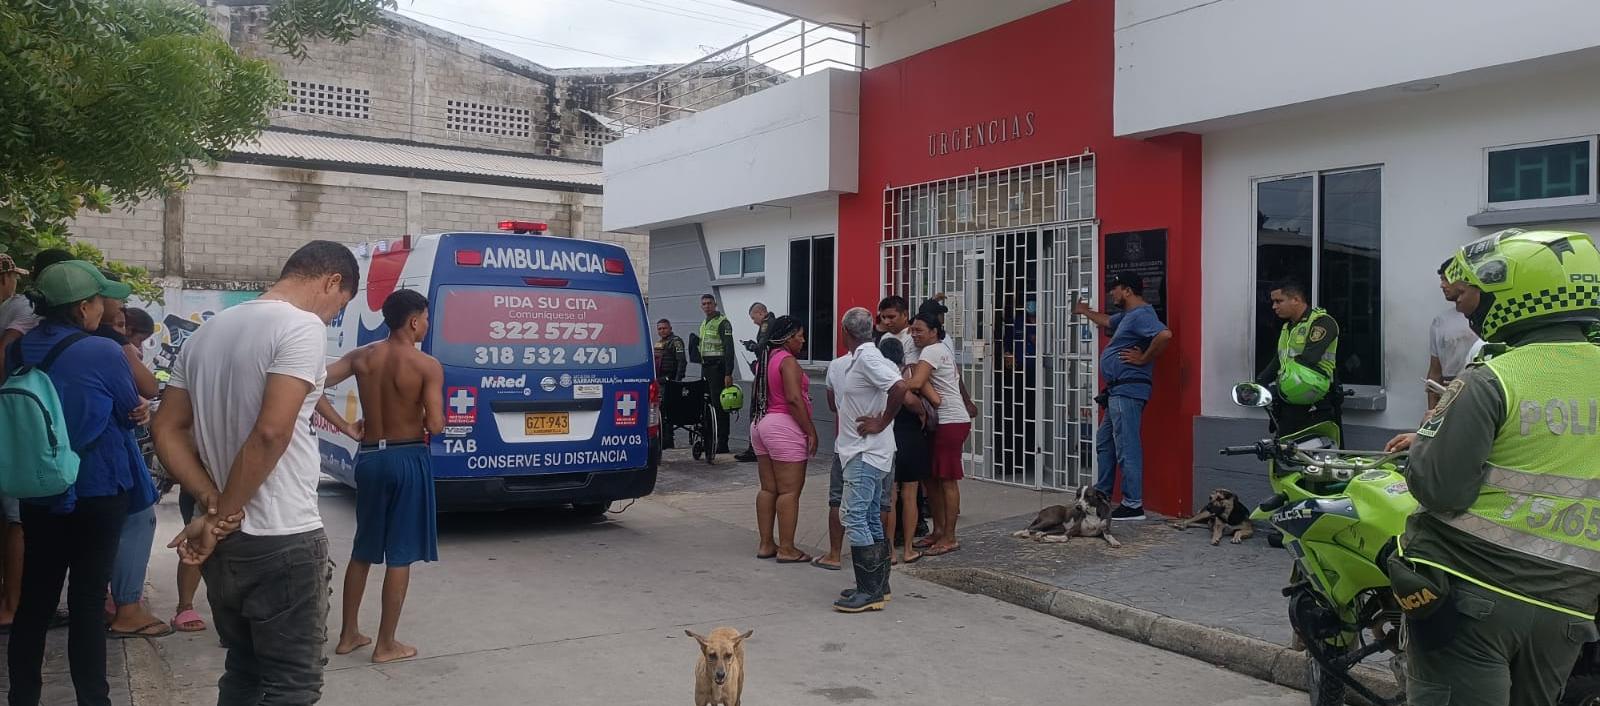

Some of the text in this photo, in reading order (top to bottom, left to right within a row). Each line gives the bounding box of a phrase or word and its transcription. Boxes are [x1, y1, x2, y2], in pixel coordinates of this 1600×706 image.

[928, 111, 1035, 157] URGENCIAS
[482, 247, 604, 273] AMBULANCIA
[494, 295, 598, 310] PIDA SU CITA
[509, 310, 586, 321] Comuníquese al
[489, 321, 604, 340] 322 5757
[474, 346, 617, 365] 318 532 4761
[481, 374, 527, 389] MiRed
[526, 416, 568, 429] GZT-943
[443, 439, 477, 453] TAB
[601, 434, 642, 446] MOV 03
[467, 449, 627, 470] CONSERVE SU DISTANCIA
